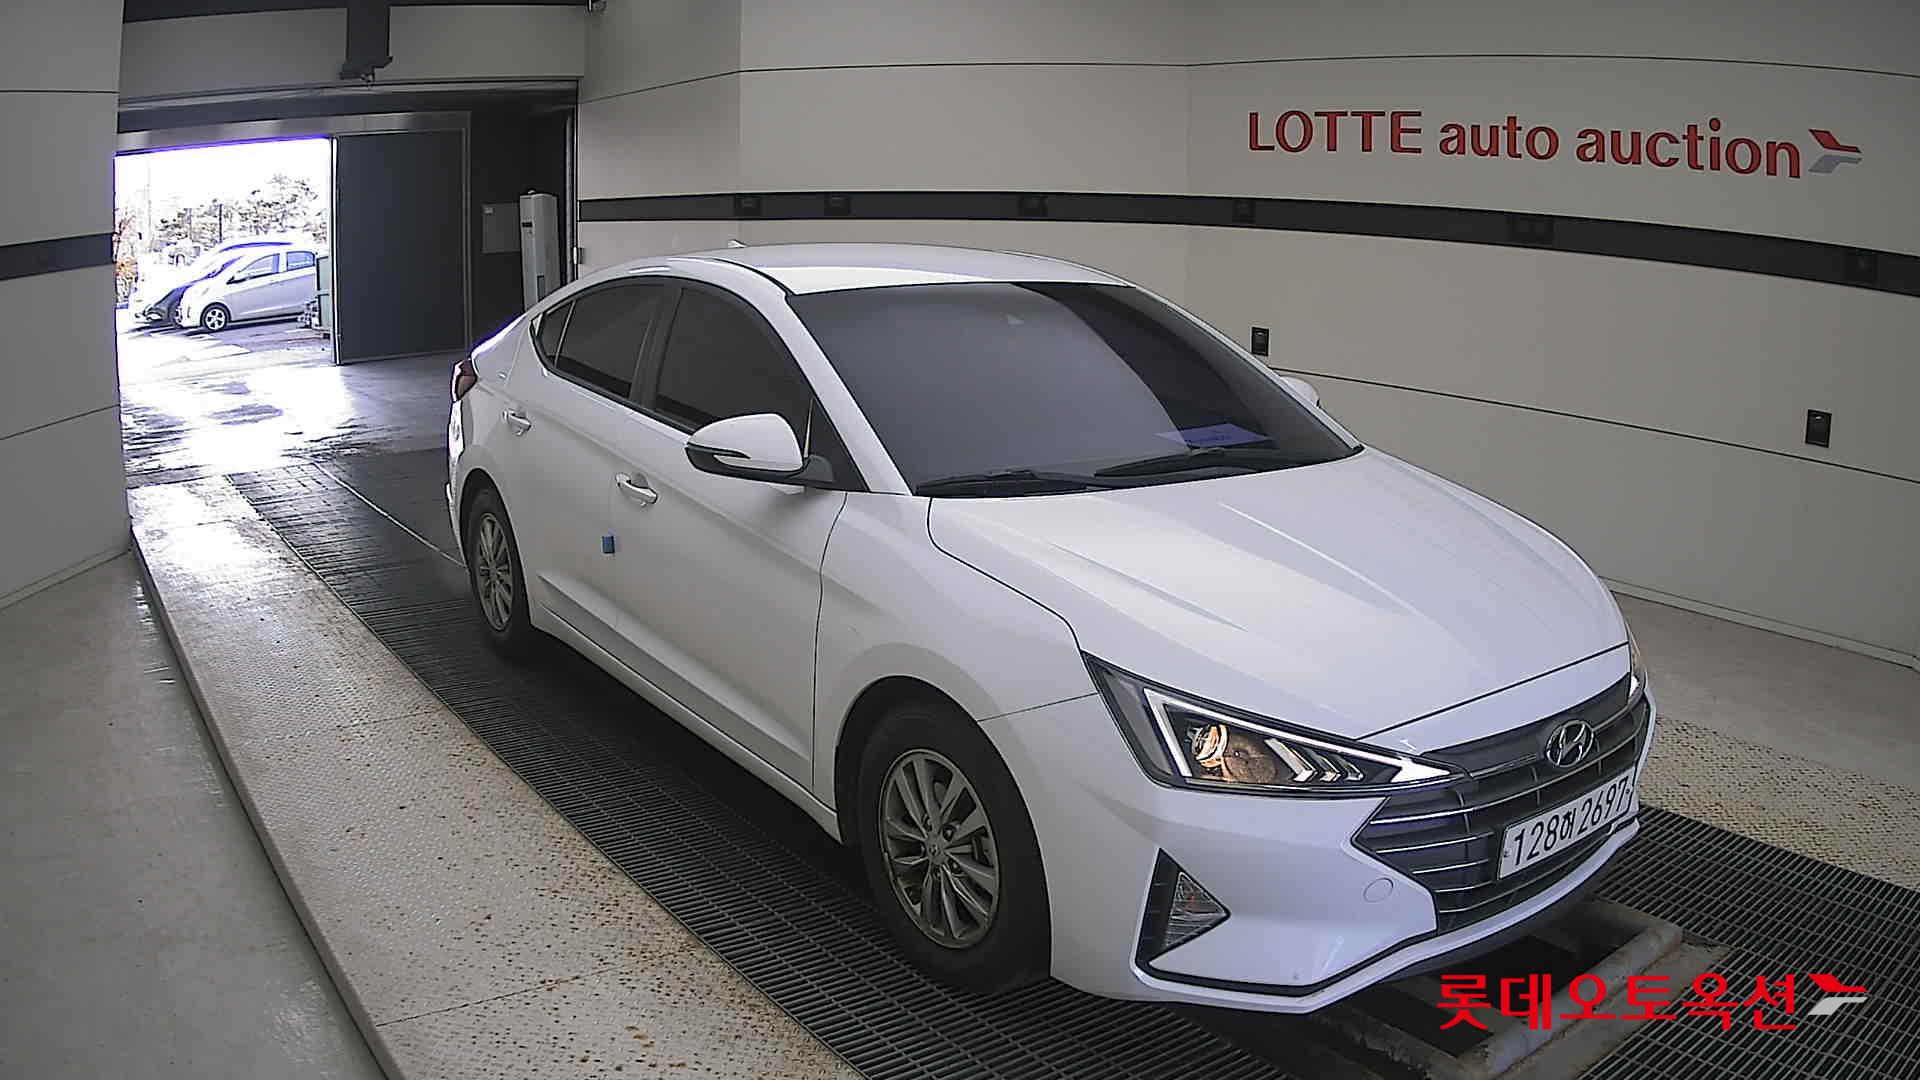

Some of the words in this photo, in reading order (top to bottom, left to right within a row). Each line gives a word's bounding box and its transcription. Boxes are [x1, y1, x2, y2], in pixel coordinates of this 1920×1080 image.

[1247, 110, 1423, 154] LOTTE
[1439, 115, 1560, 160] auto
[1575, 117, 1802, 179] auction
